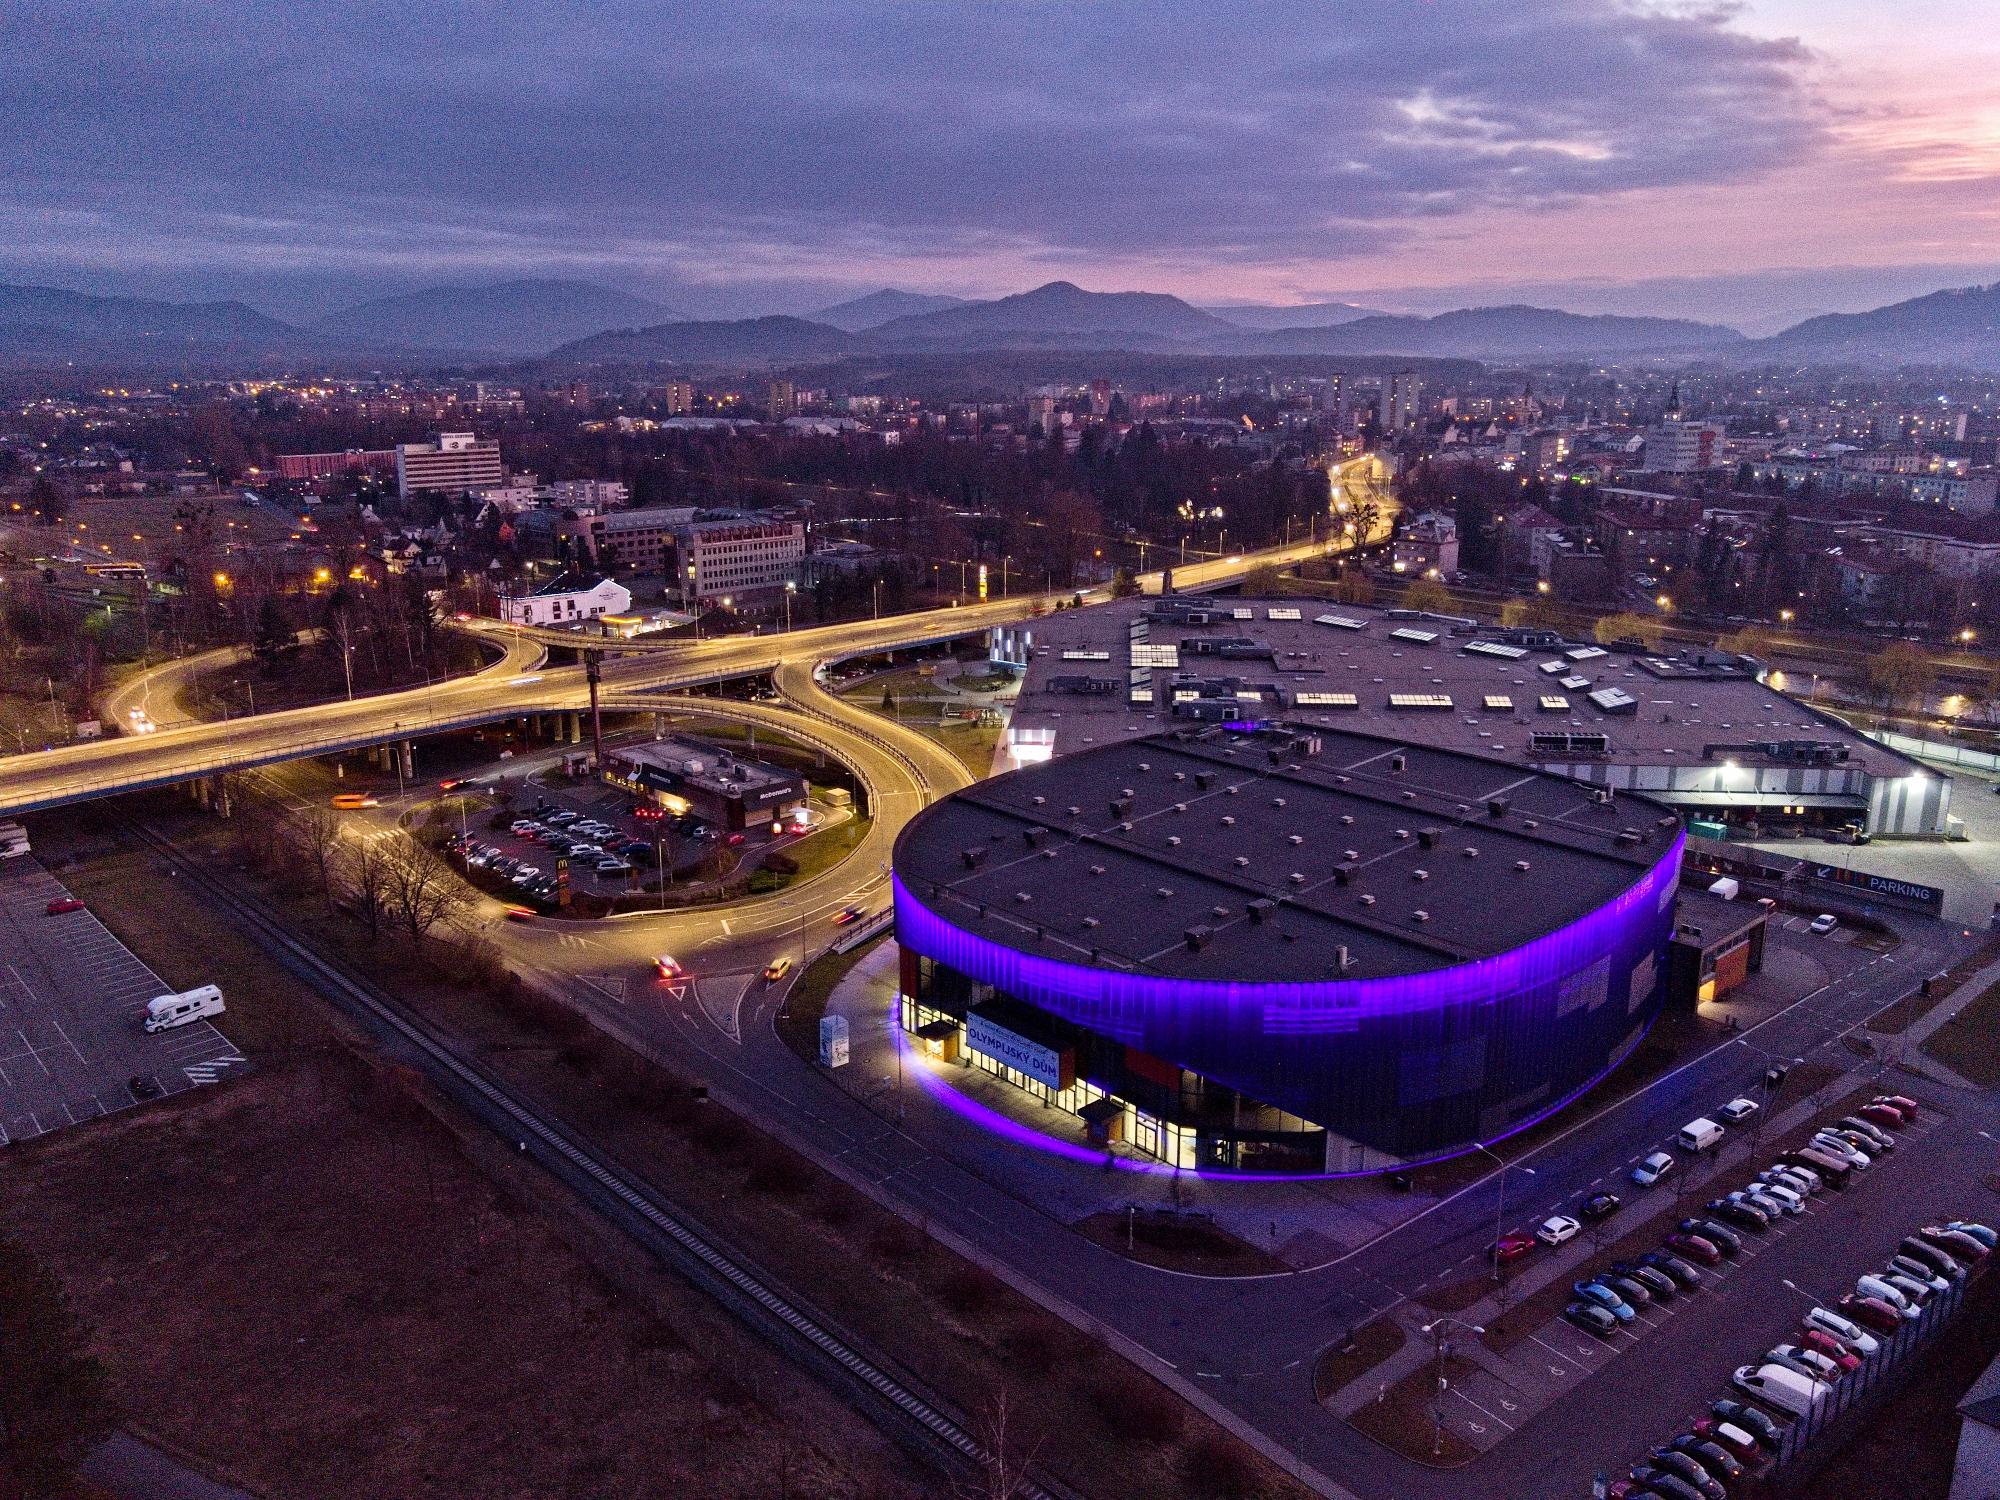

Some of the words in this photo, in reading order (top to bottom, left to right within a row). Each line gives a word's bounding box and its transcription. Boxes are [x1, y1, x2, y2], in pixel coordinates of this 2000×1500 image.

[1870, 877, 1930, 899] PARKING
[969, 1028, 1030, 1064] OLYMPIJSKÝ
[1033, 1057, 1057, 1077] DŮM
